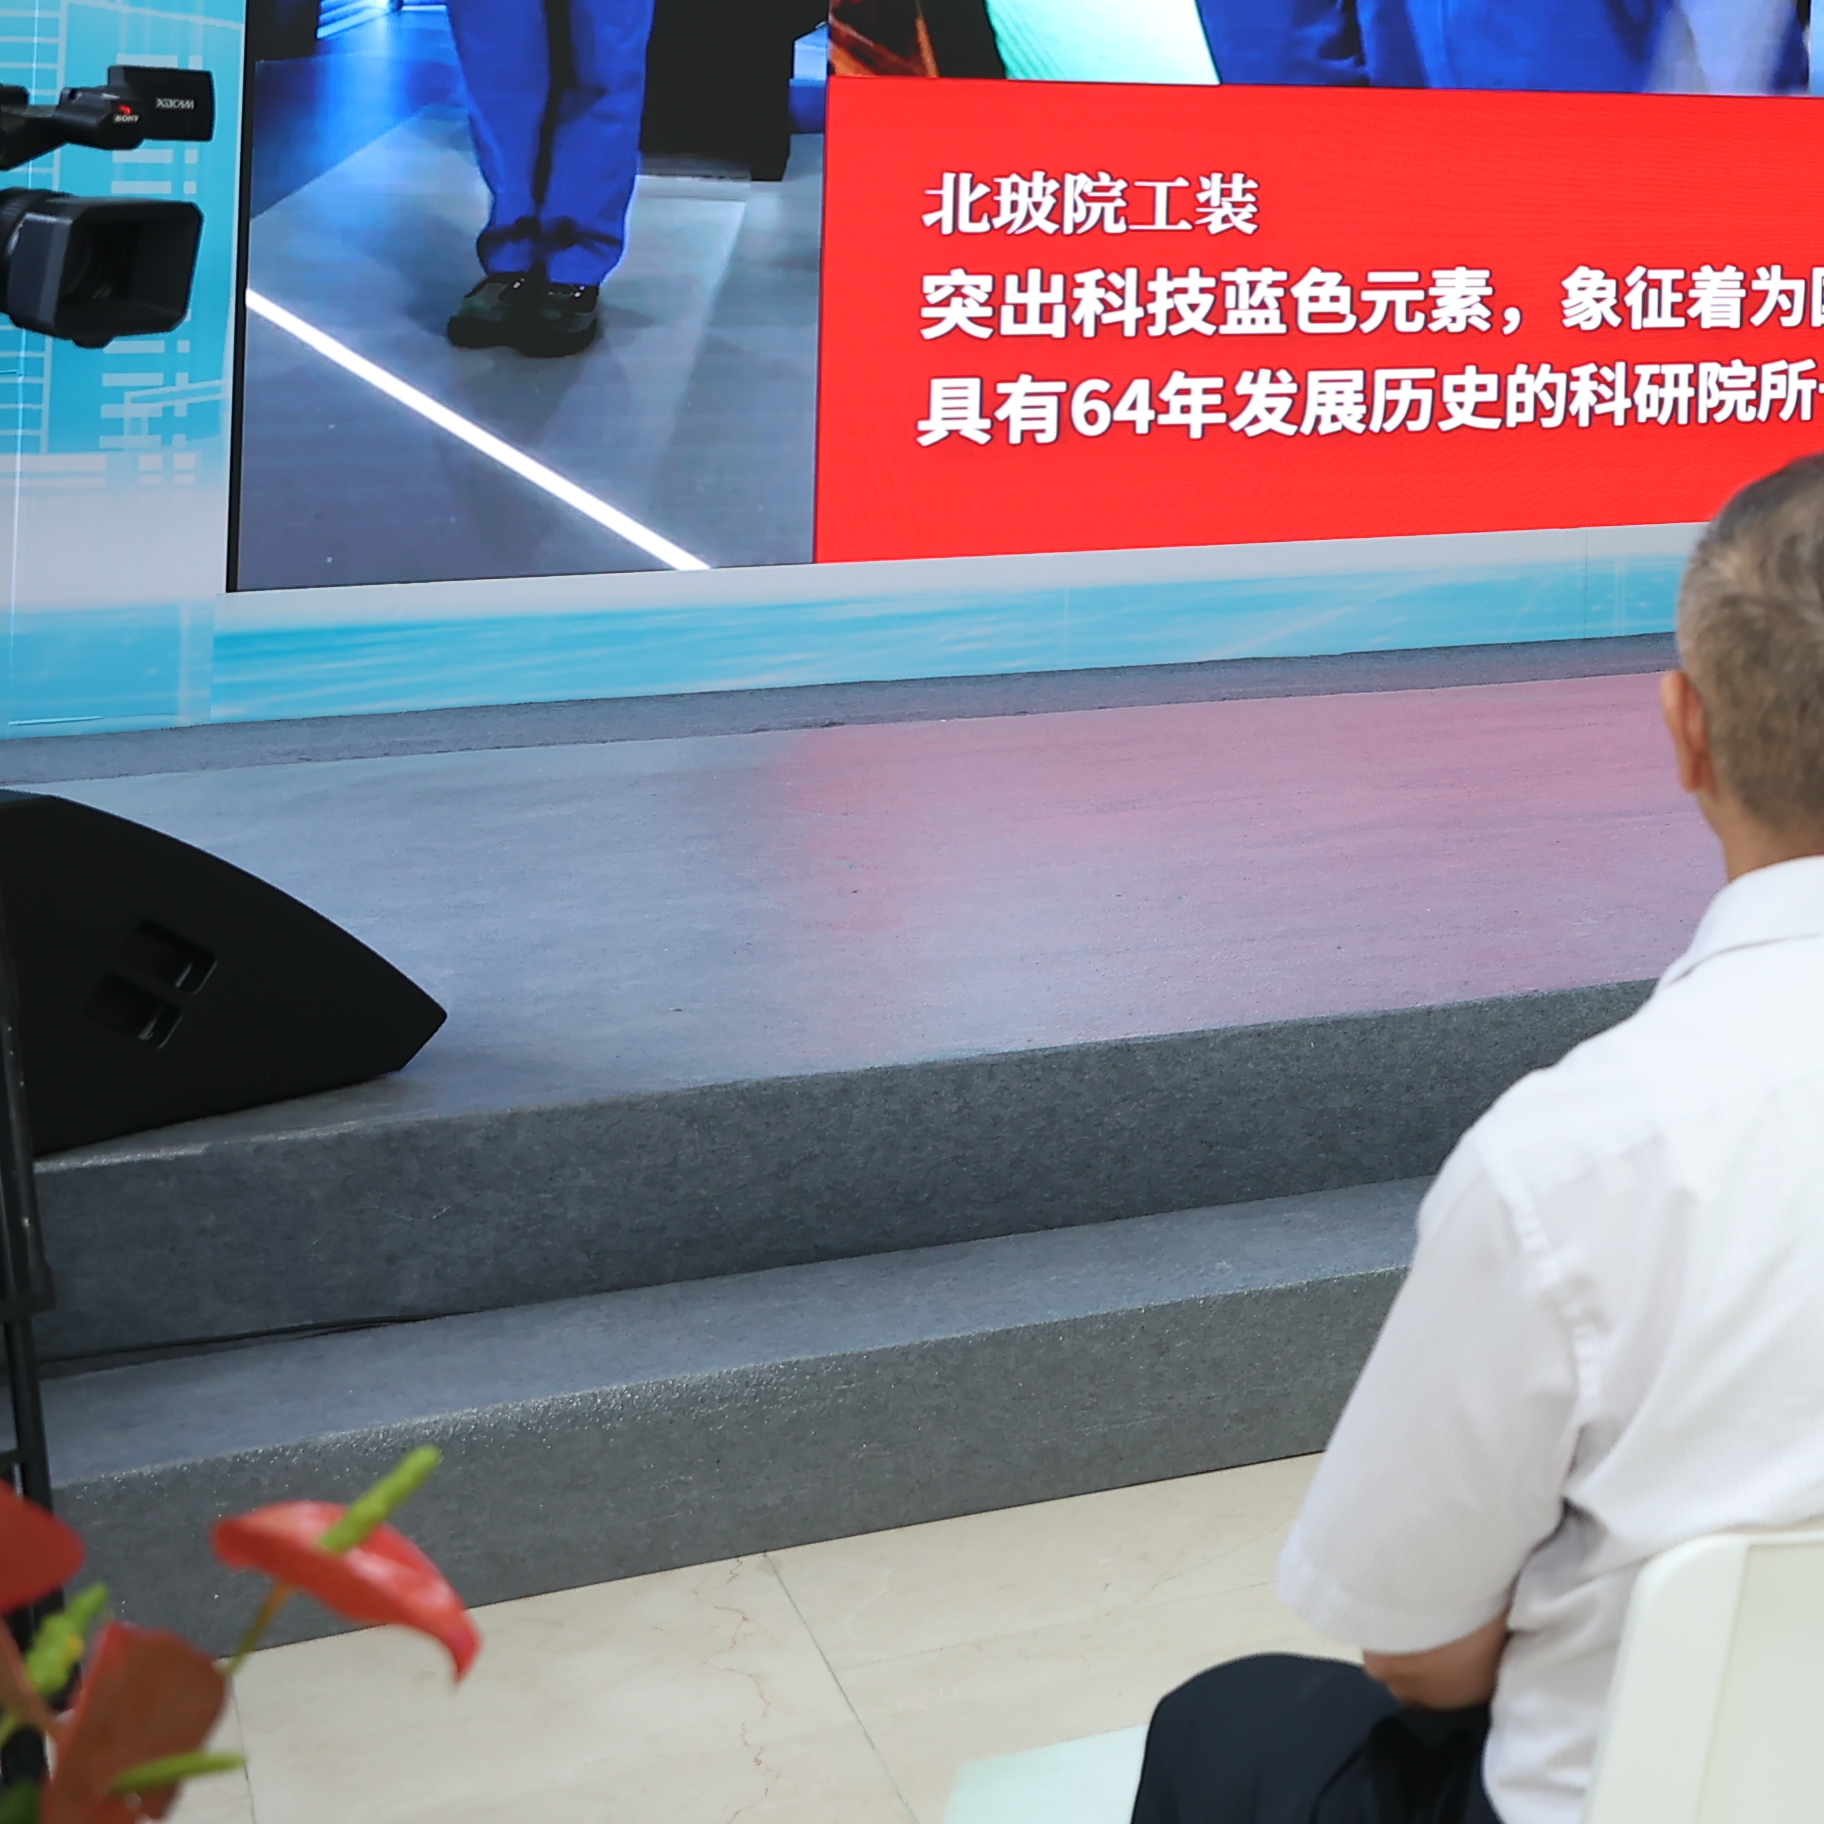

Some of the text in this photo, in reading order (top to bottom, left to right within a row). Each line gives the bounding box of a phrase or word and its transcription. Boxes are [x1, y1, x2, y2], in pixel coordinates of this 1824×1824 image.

[156, 98, 195, 109] XDCAM
[114, 115, 139, 123] SONY
[921, 170, 1260, 236] 北玻院工装
